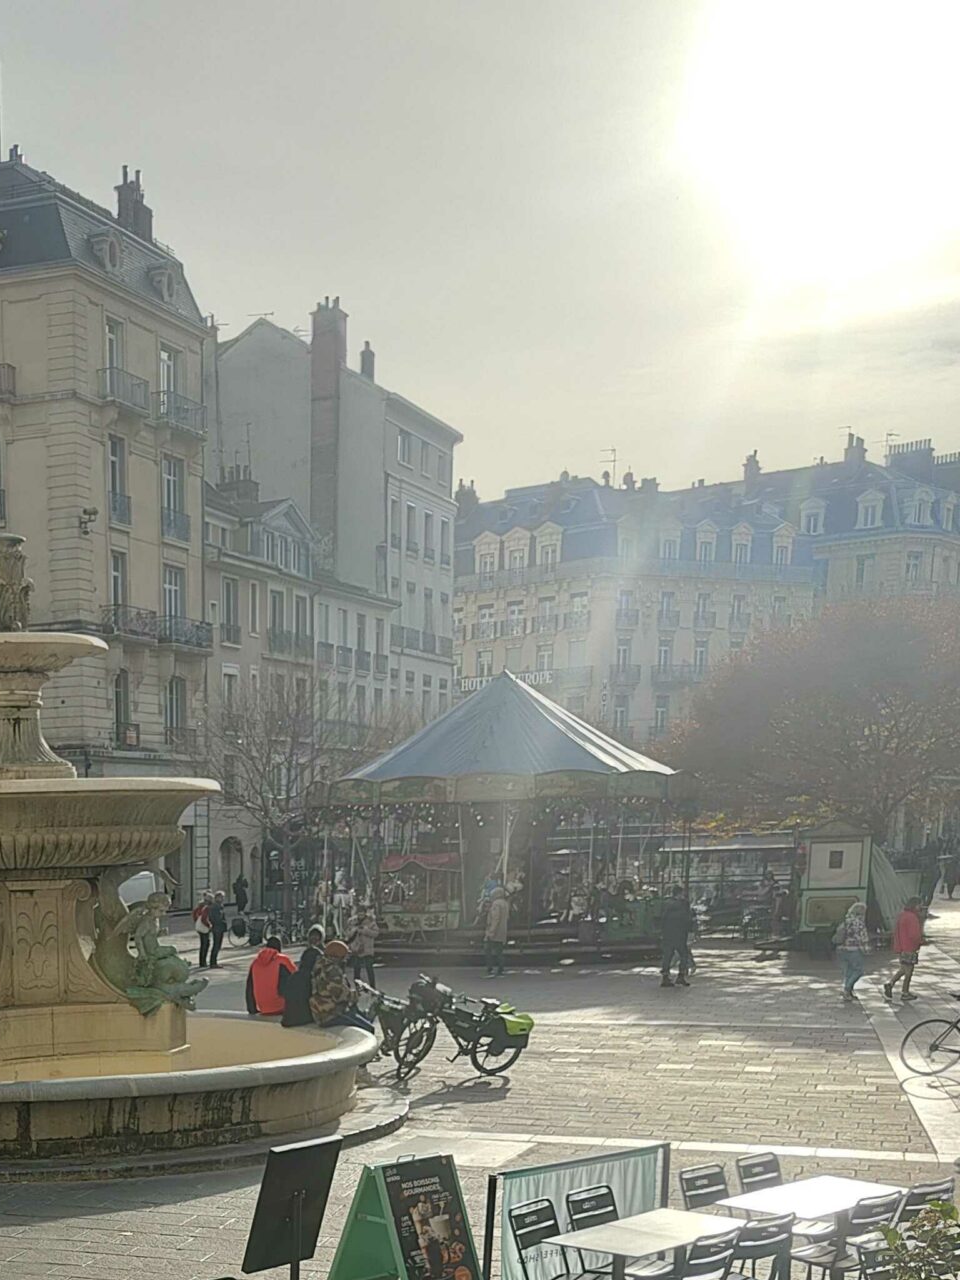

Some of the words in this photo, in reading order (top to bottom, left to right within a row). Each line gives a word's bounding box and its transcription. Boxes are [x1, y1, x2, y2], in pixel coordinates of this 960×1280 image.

[401, 1181, 414, 1189] NOS
[413, 1176, 440, 1187] BOISSONS
[403, 1183, 441, 1197] GOURMANDES
